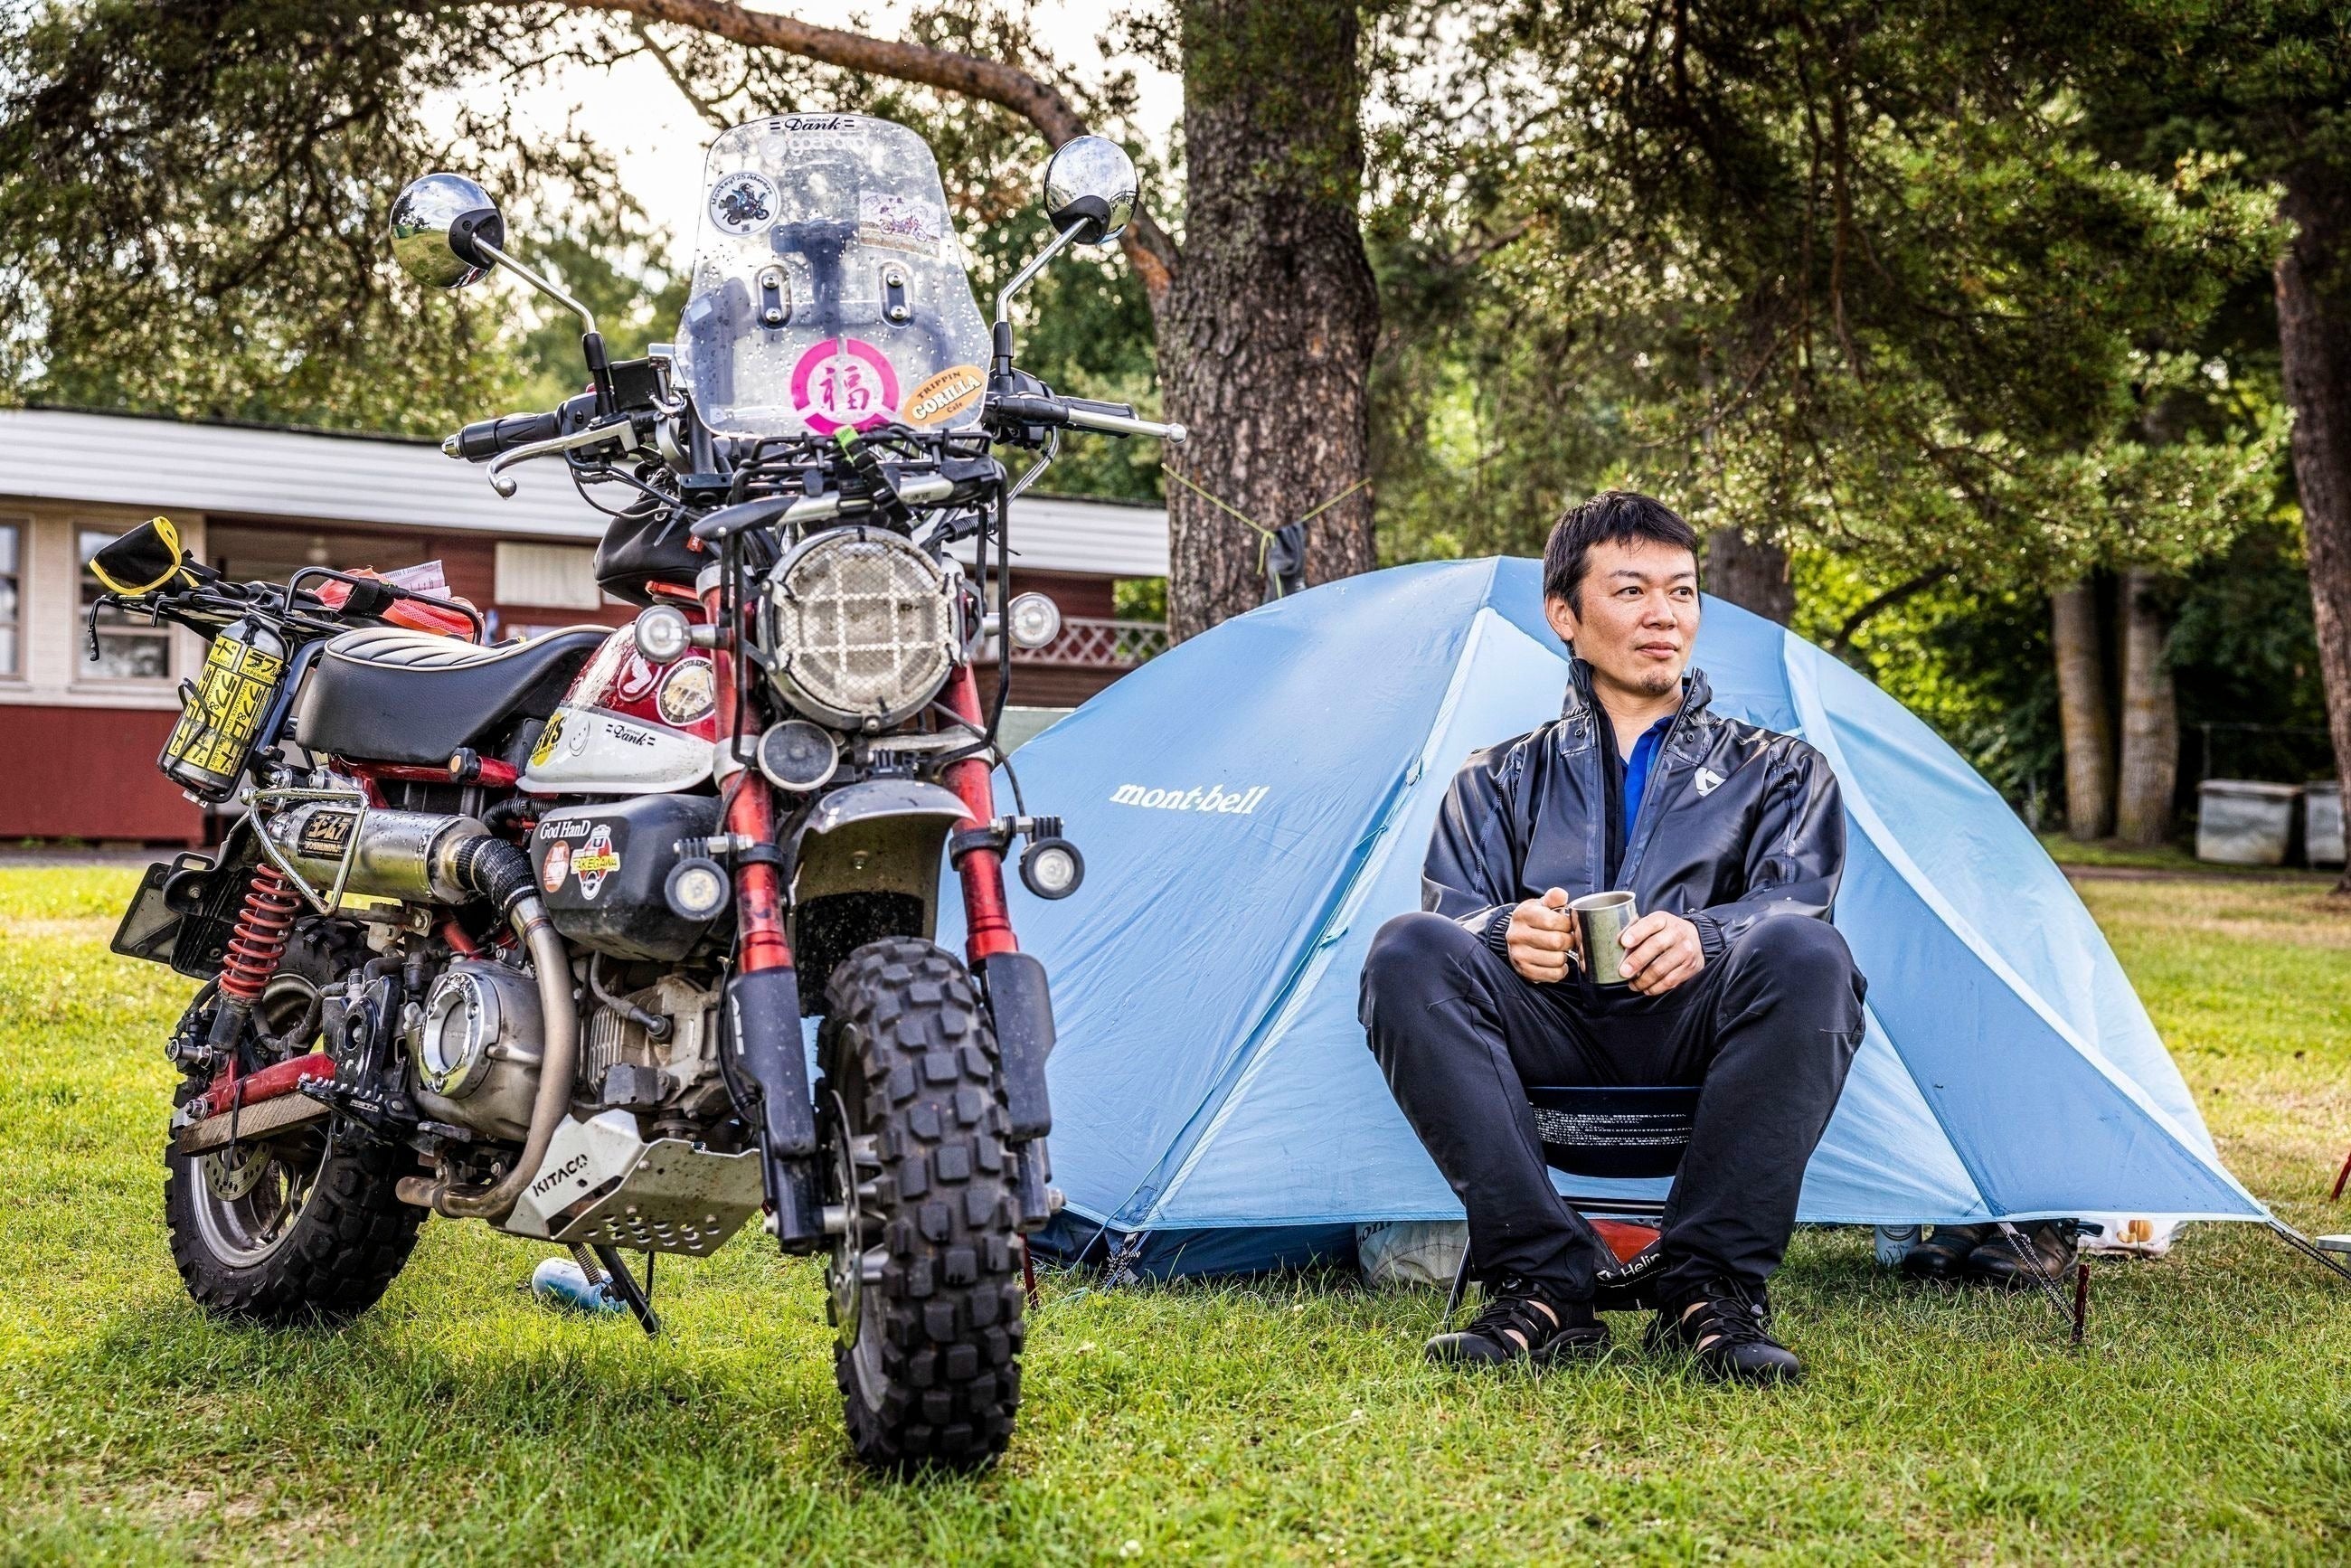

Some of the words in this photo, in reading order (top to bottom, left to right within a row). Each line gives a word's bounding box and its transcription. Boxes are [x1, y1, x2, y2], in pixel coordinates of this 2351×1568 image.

[819, 365, 870, 411] 福
[911, 374, 983, 420] GORILLA
[917, 371, 962, 399] TRIPPIN
[540, 822, 561, 840] God
[559, 819, 591, 838] HanD
[532, 1153, 589, 1197] KITACO
